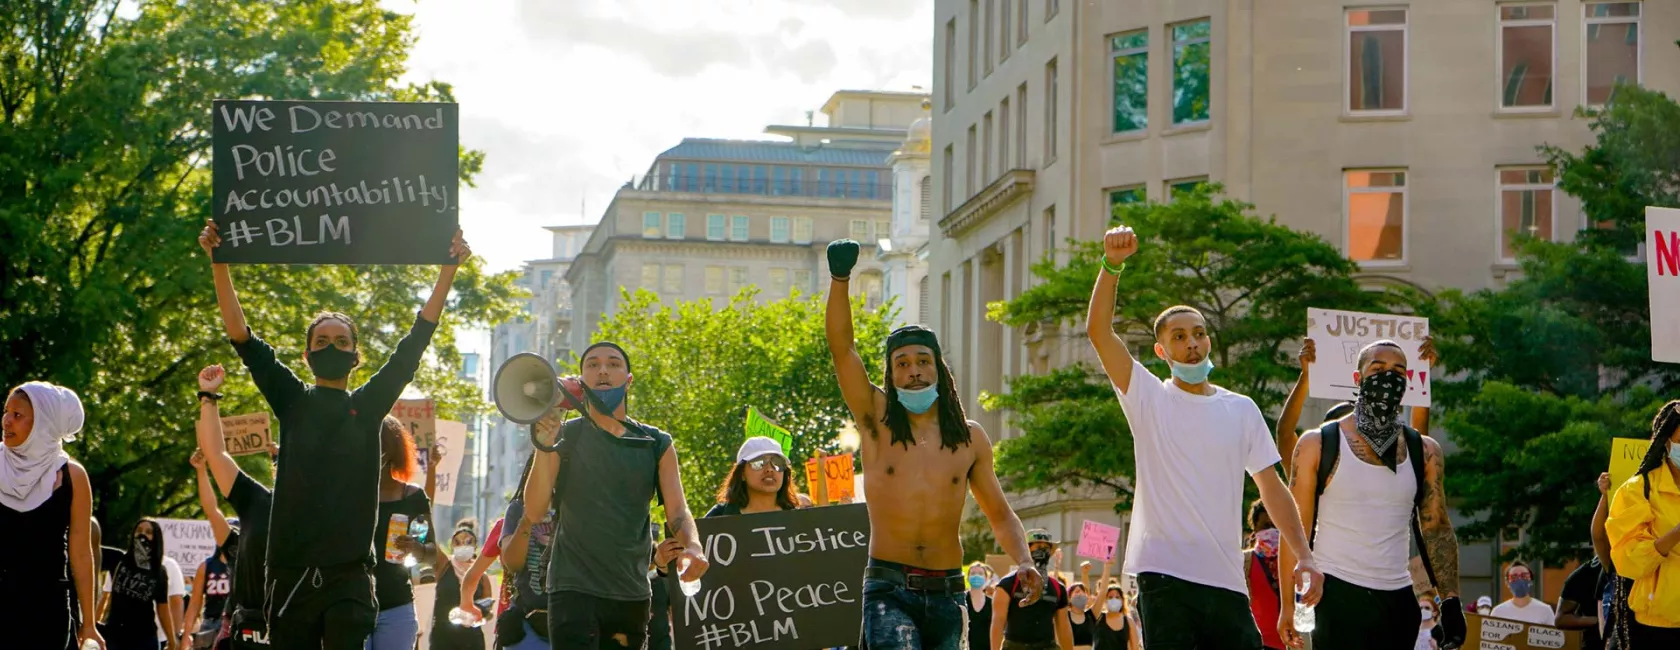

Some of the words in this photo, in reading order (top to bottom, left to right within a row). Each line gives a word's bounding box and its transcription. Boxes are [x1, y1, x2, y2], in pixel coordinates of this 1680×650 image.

[220, 104, 276, 133] We
[288, 105, 443, 133] Demand
[231, 144, 337, 180] Police
[224, 214, 352, 248] #BLM
[1654, 230, 1680, 276] N
[1326, 314, 1427, 341] JUSTICE
[224, 428, 270, 452] TAND!
[164, 523, 212, 540] MERCHAN
[751, 526, 867, 557] Justice
[206, 579, 231, 595] 20
[684, 585, 736, 627] NO
[750, 580, 855, 616] Peace
[695, 616, 799, 650] #BLM
[1482, 619, 1521, 632] ASIANS
[1482, 630, 1502, 640] FOR
[1529, 626, 1562, 638] BLACK
[1481, 642, 1514, 650] BLACK
[1528, 638, 1561, 648] LIVES
